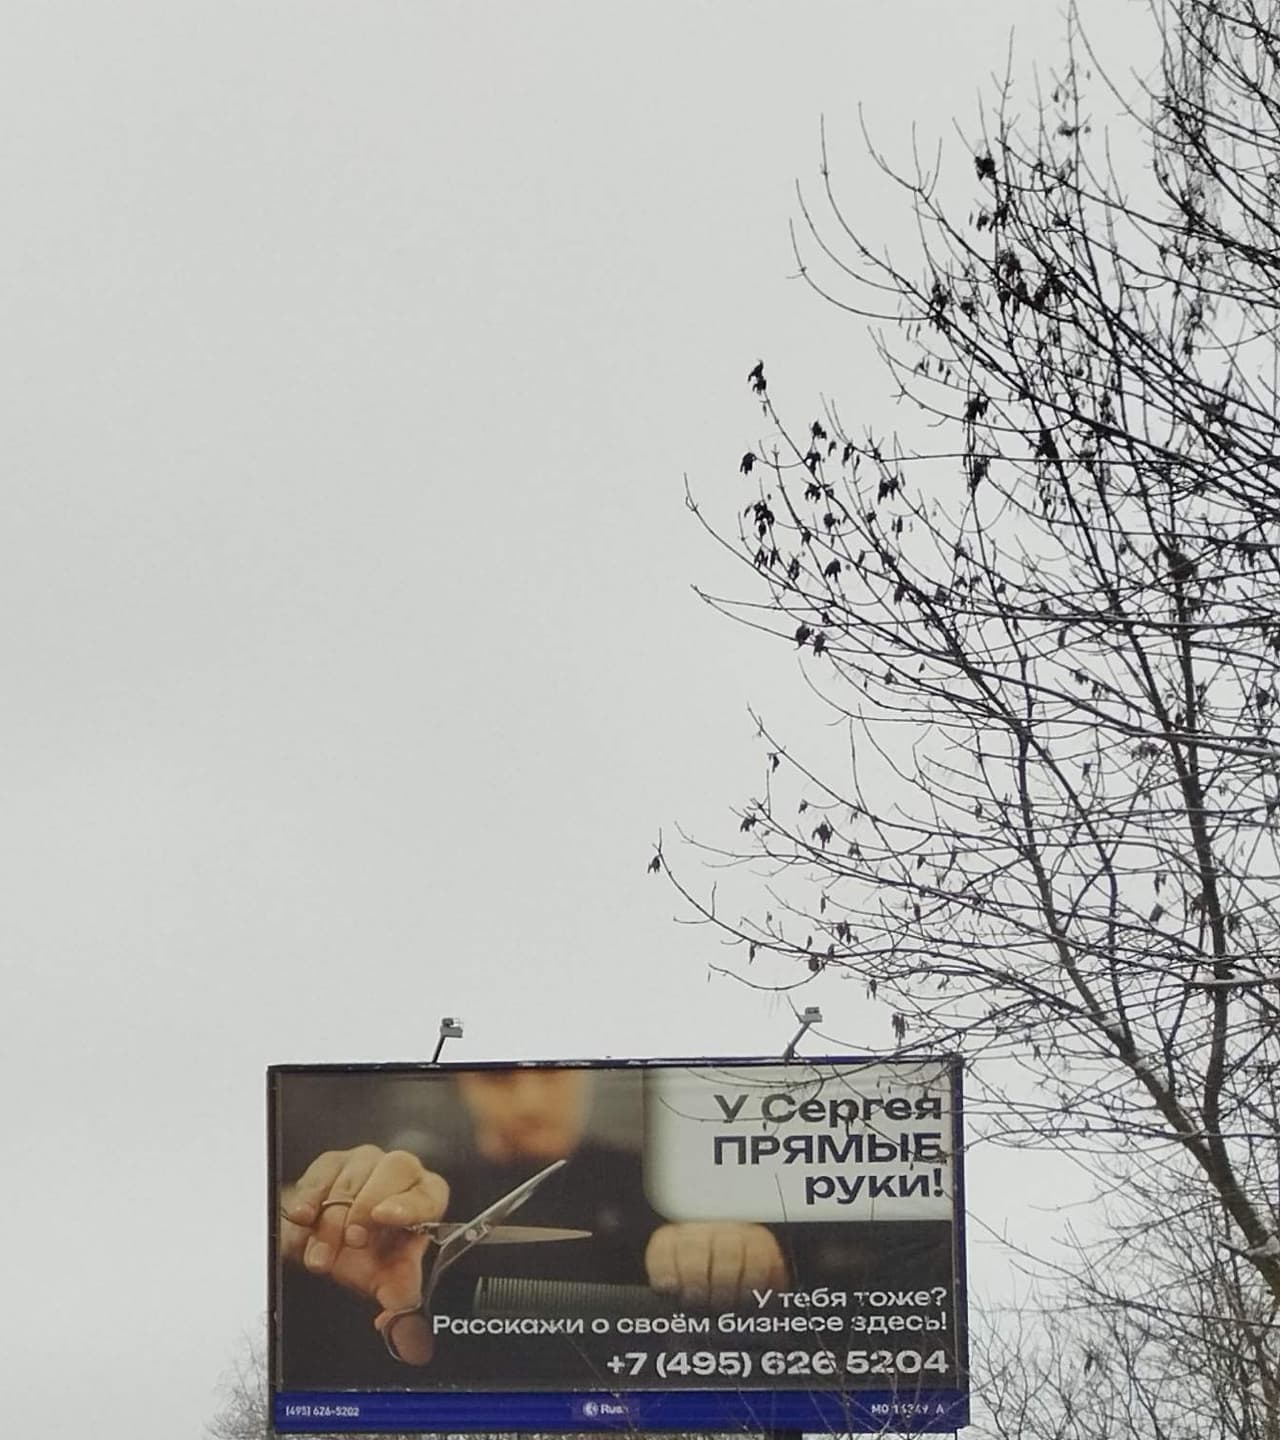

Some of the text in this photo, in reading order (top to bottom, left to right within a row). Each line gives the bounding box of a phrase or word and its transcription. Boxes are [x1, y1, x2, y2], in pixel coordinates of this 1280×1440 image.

[713, 1093, 942, 1128] У Сергея
[714, 1133, 943, 1165] ПРЯМЫЕ
[805, 1168, 943, 1205] руки!
[752, 1286, 947, 1308] У тебя тоже?
[432, 1311, 947, 1334] Расскажи о своём бизнесе здесь!
[607, 1350, 949, 1378] +7 (495) 626 5204
